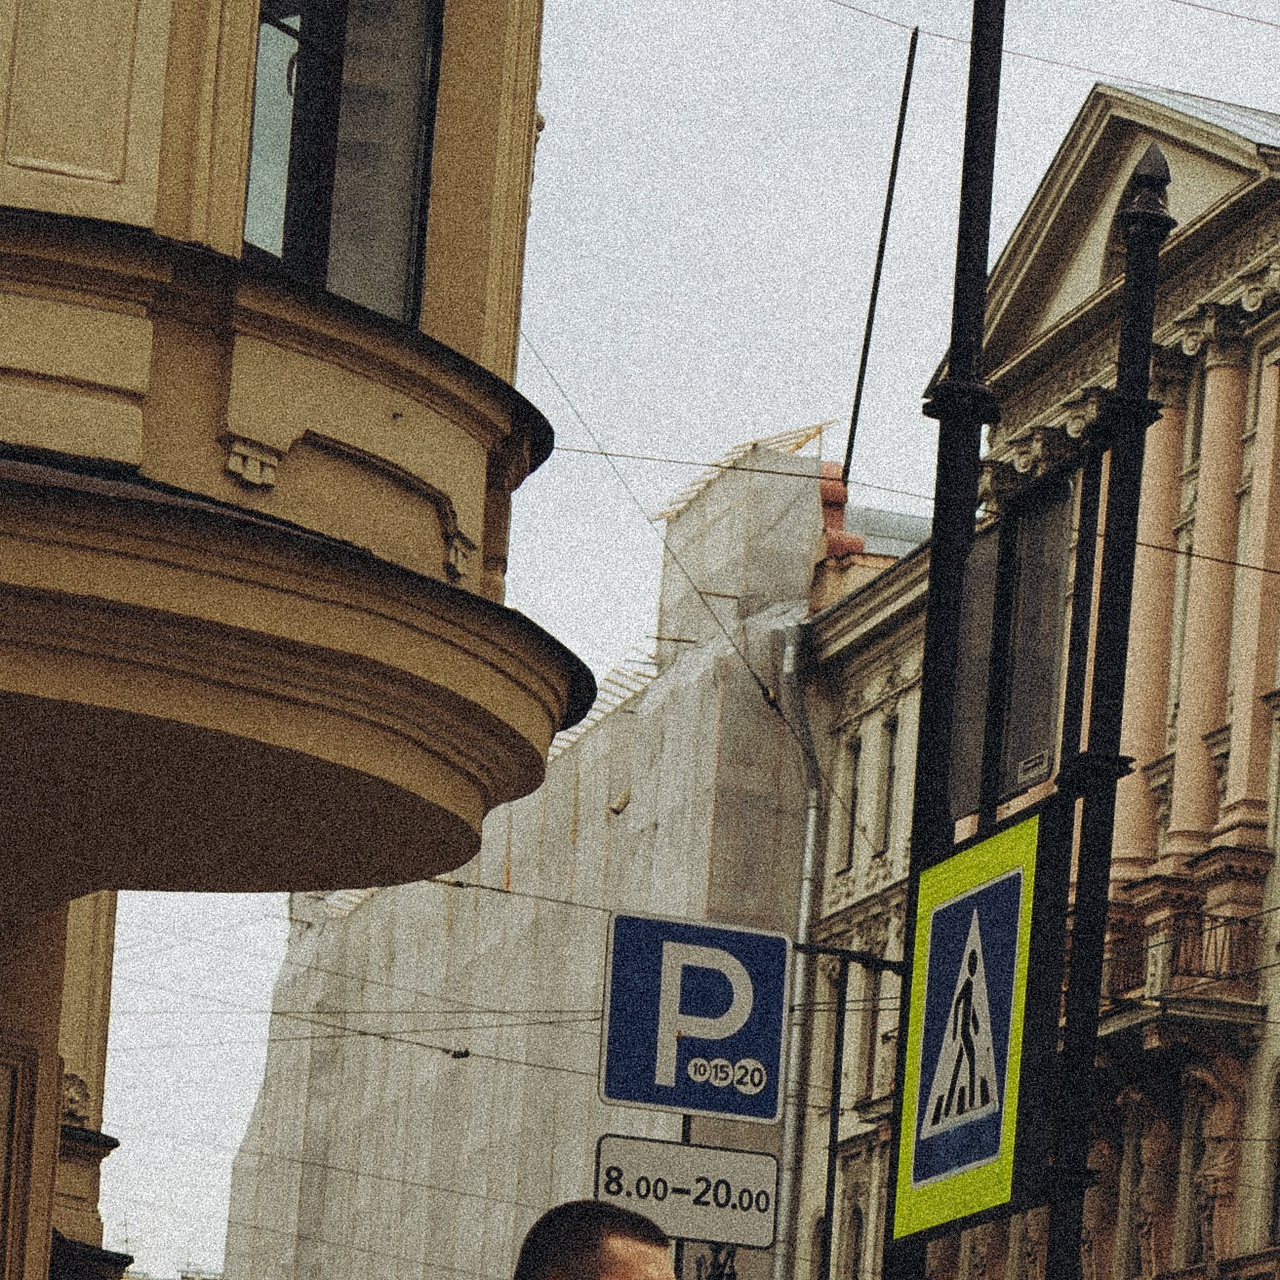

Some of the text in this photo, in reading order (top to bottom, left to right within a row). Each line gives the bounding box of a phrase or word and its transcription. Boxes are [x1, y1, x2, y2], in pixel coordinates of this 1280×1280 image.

[654, 940, 754, 1088] P
[692, 1062, 764, 1088] 10 15 20
